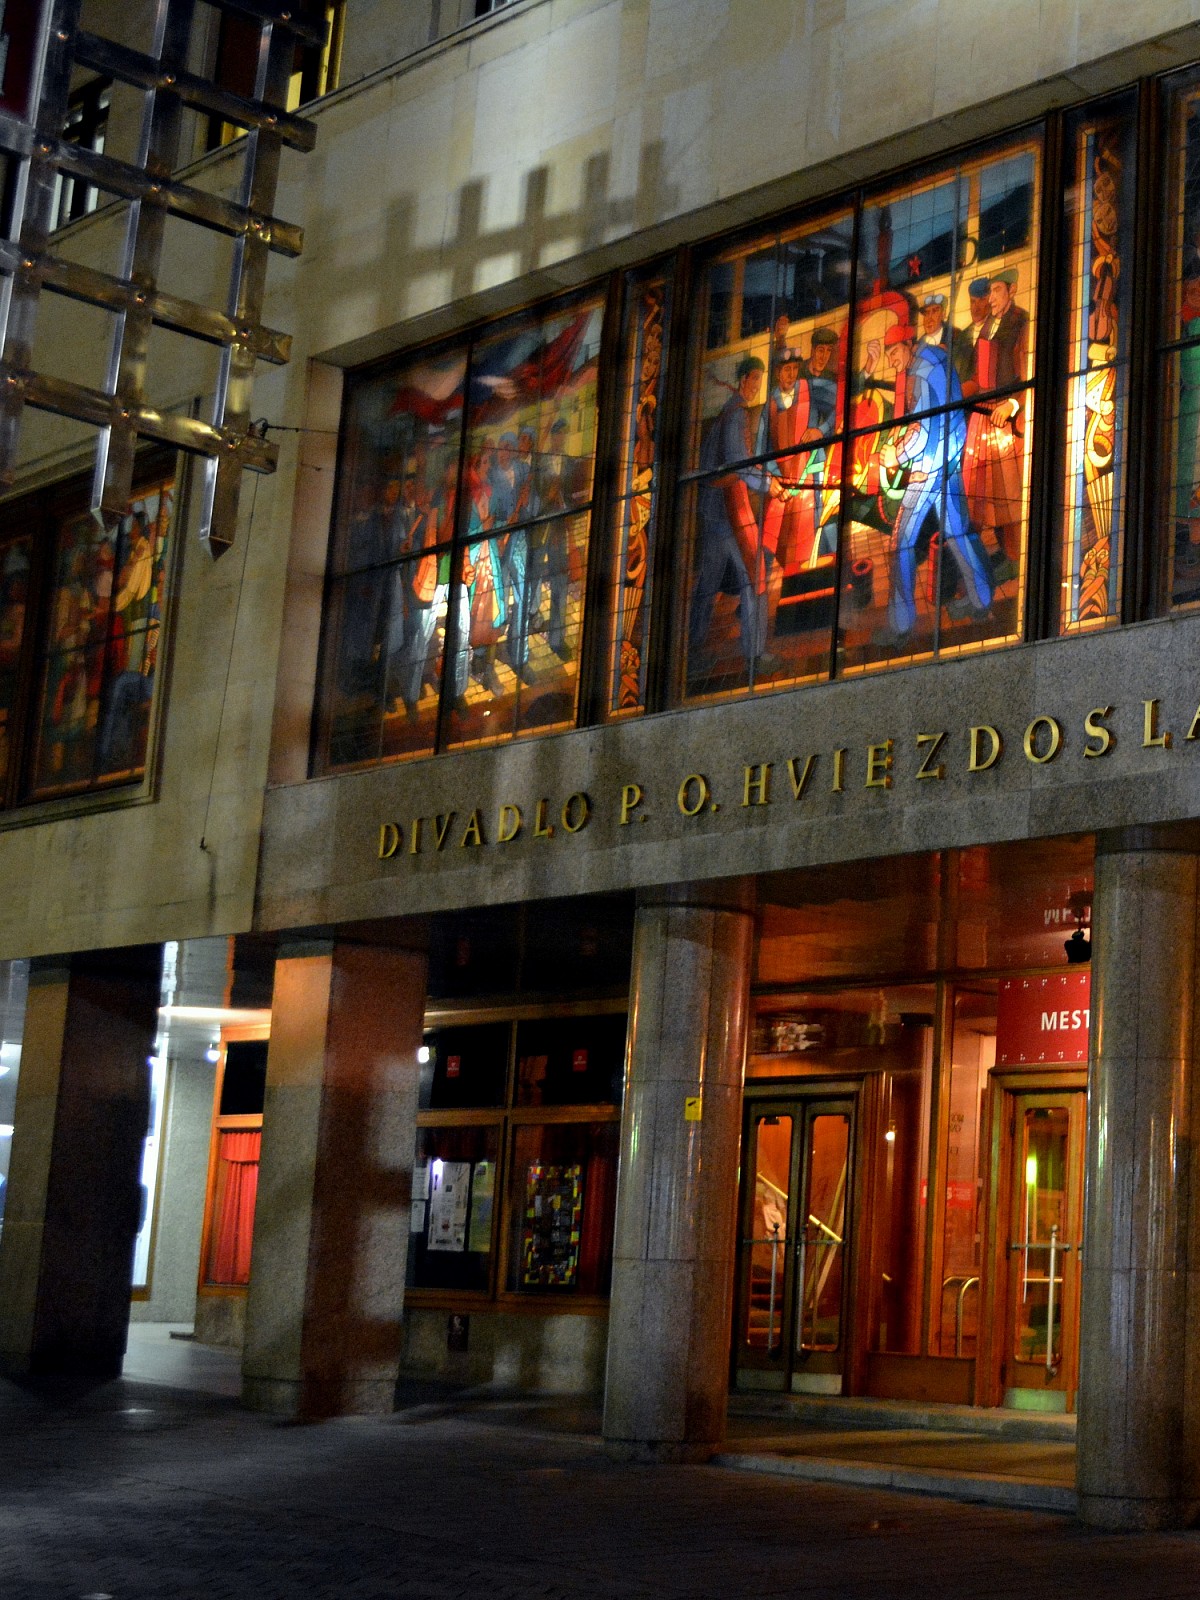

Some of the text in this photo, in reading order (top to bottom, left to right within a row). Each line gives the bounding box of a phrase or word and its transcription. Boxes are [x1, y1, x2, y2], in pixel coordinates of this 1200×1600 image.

[378, 791, 591, 860] DIVADLO
[619, 783, 647, 826] P.
[677, 772, 720, 817] O.
[1041, 1008, 1091, 1031] MEST
